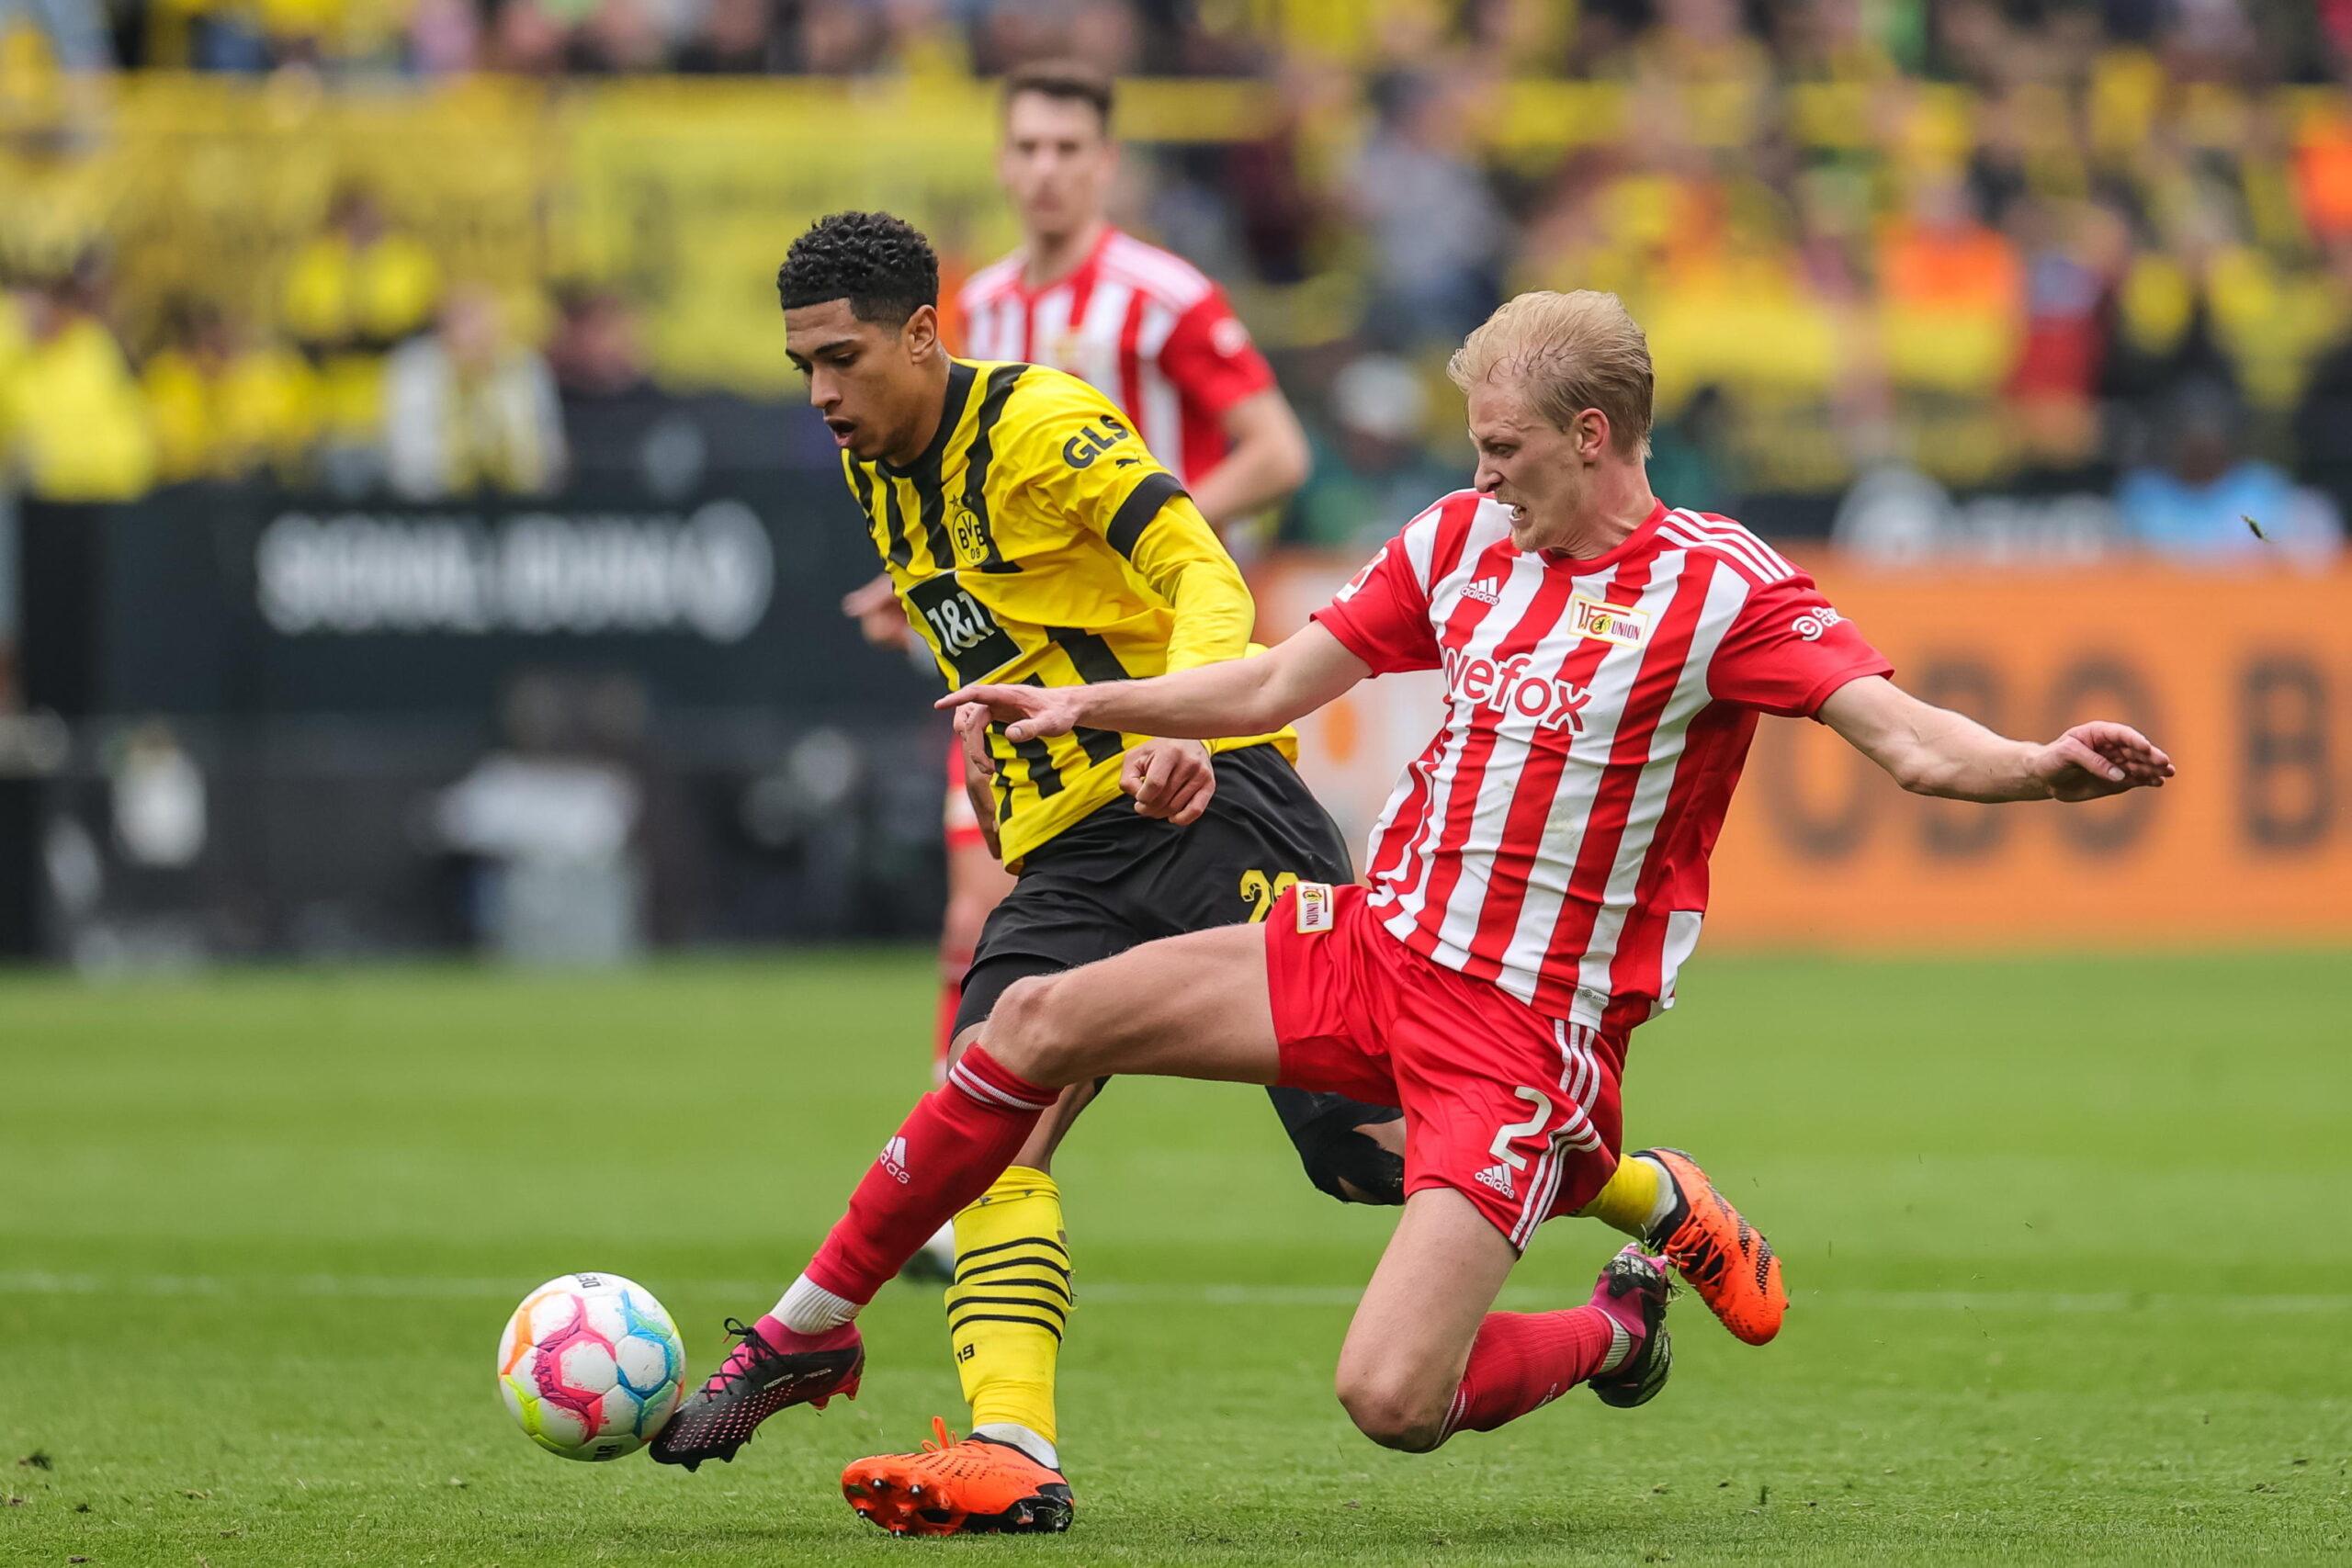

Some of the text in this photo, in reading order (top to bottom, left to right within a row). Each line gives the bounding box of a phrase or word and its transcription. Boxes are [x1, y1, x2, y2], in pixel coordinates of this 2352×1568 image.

[1062, 414, 1129, 469] GLS
[957, 513, 986, 549] BVB
[1460, 585, 1500, 606] adidas
[926, 590, 995, 658] 1&1
[1611, 620, 1641, 640] UNION
[1442, 649, 1593, 733] wefox
[1306, 902, 1319, 926] UNION
[1489, 1086, 1553, 1171] 2
[1474, 1171, 1515, 1200] adidas
